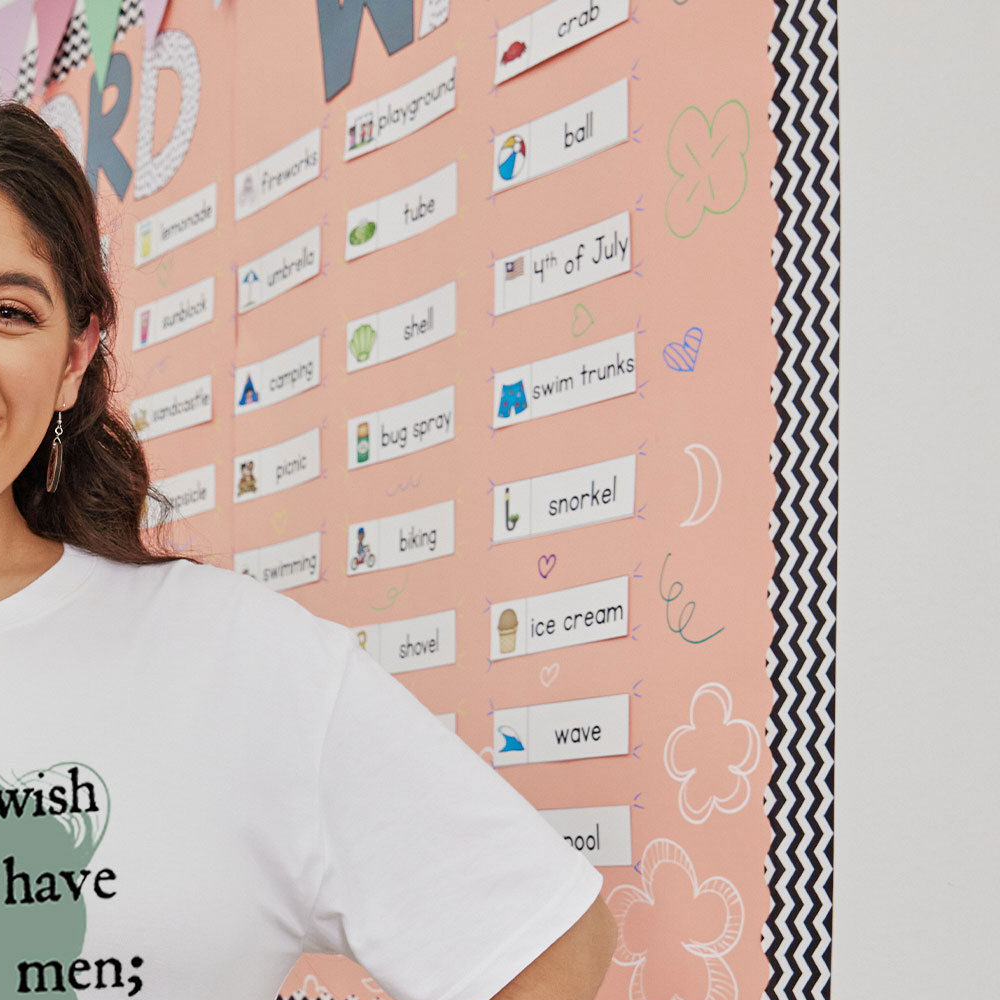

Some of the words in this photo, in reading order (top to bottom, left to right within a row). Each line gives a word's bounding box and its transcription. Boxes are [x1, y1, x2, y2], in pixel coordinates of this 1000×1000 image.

[557, 0, 600, 38] crab
[377, 66, 457, 135] playground
[564, 110, 594, 149] ball
[261, 147, 318, 194] fireworks
[161, 198, 213, 241] lemonade
[403, 195, 436, 225] tube
[267, 246, 316, 288] umbrella
[533, 250, 558, 284] 4th
[563, 243, 586, 275] of
[592, 230, 629, 265] July
[402, 305, 435, 341] shell
[268, 360, 314, 391] camping
[532, 375, 575, 400] swim
[580, 352, 636, 387] trunks
[380, 423, 408, 449] bug
[412, 411, 453, 443] spray
[275, 455, 307, 485] picnic
[548, 475, 618, 517] snorkel
[399, 525, 438, 552] biking
[262, 554, 317, 583] swimming
[530, 617, 556, 638] ice
[563, 604, 624, 633] cream
[398, 627, 440, 659] shovel
[554, 725, 602, 745] wave
[3, 856, 118, 906] have
[16, 954, 145, 998] men;
